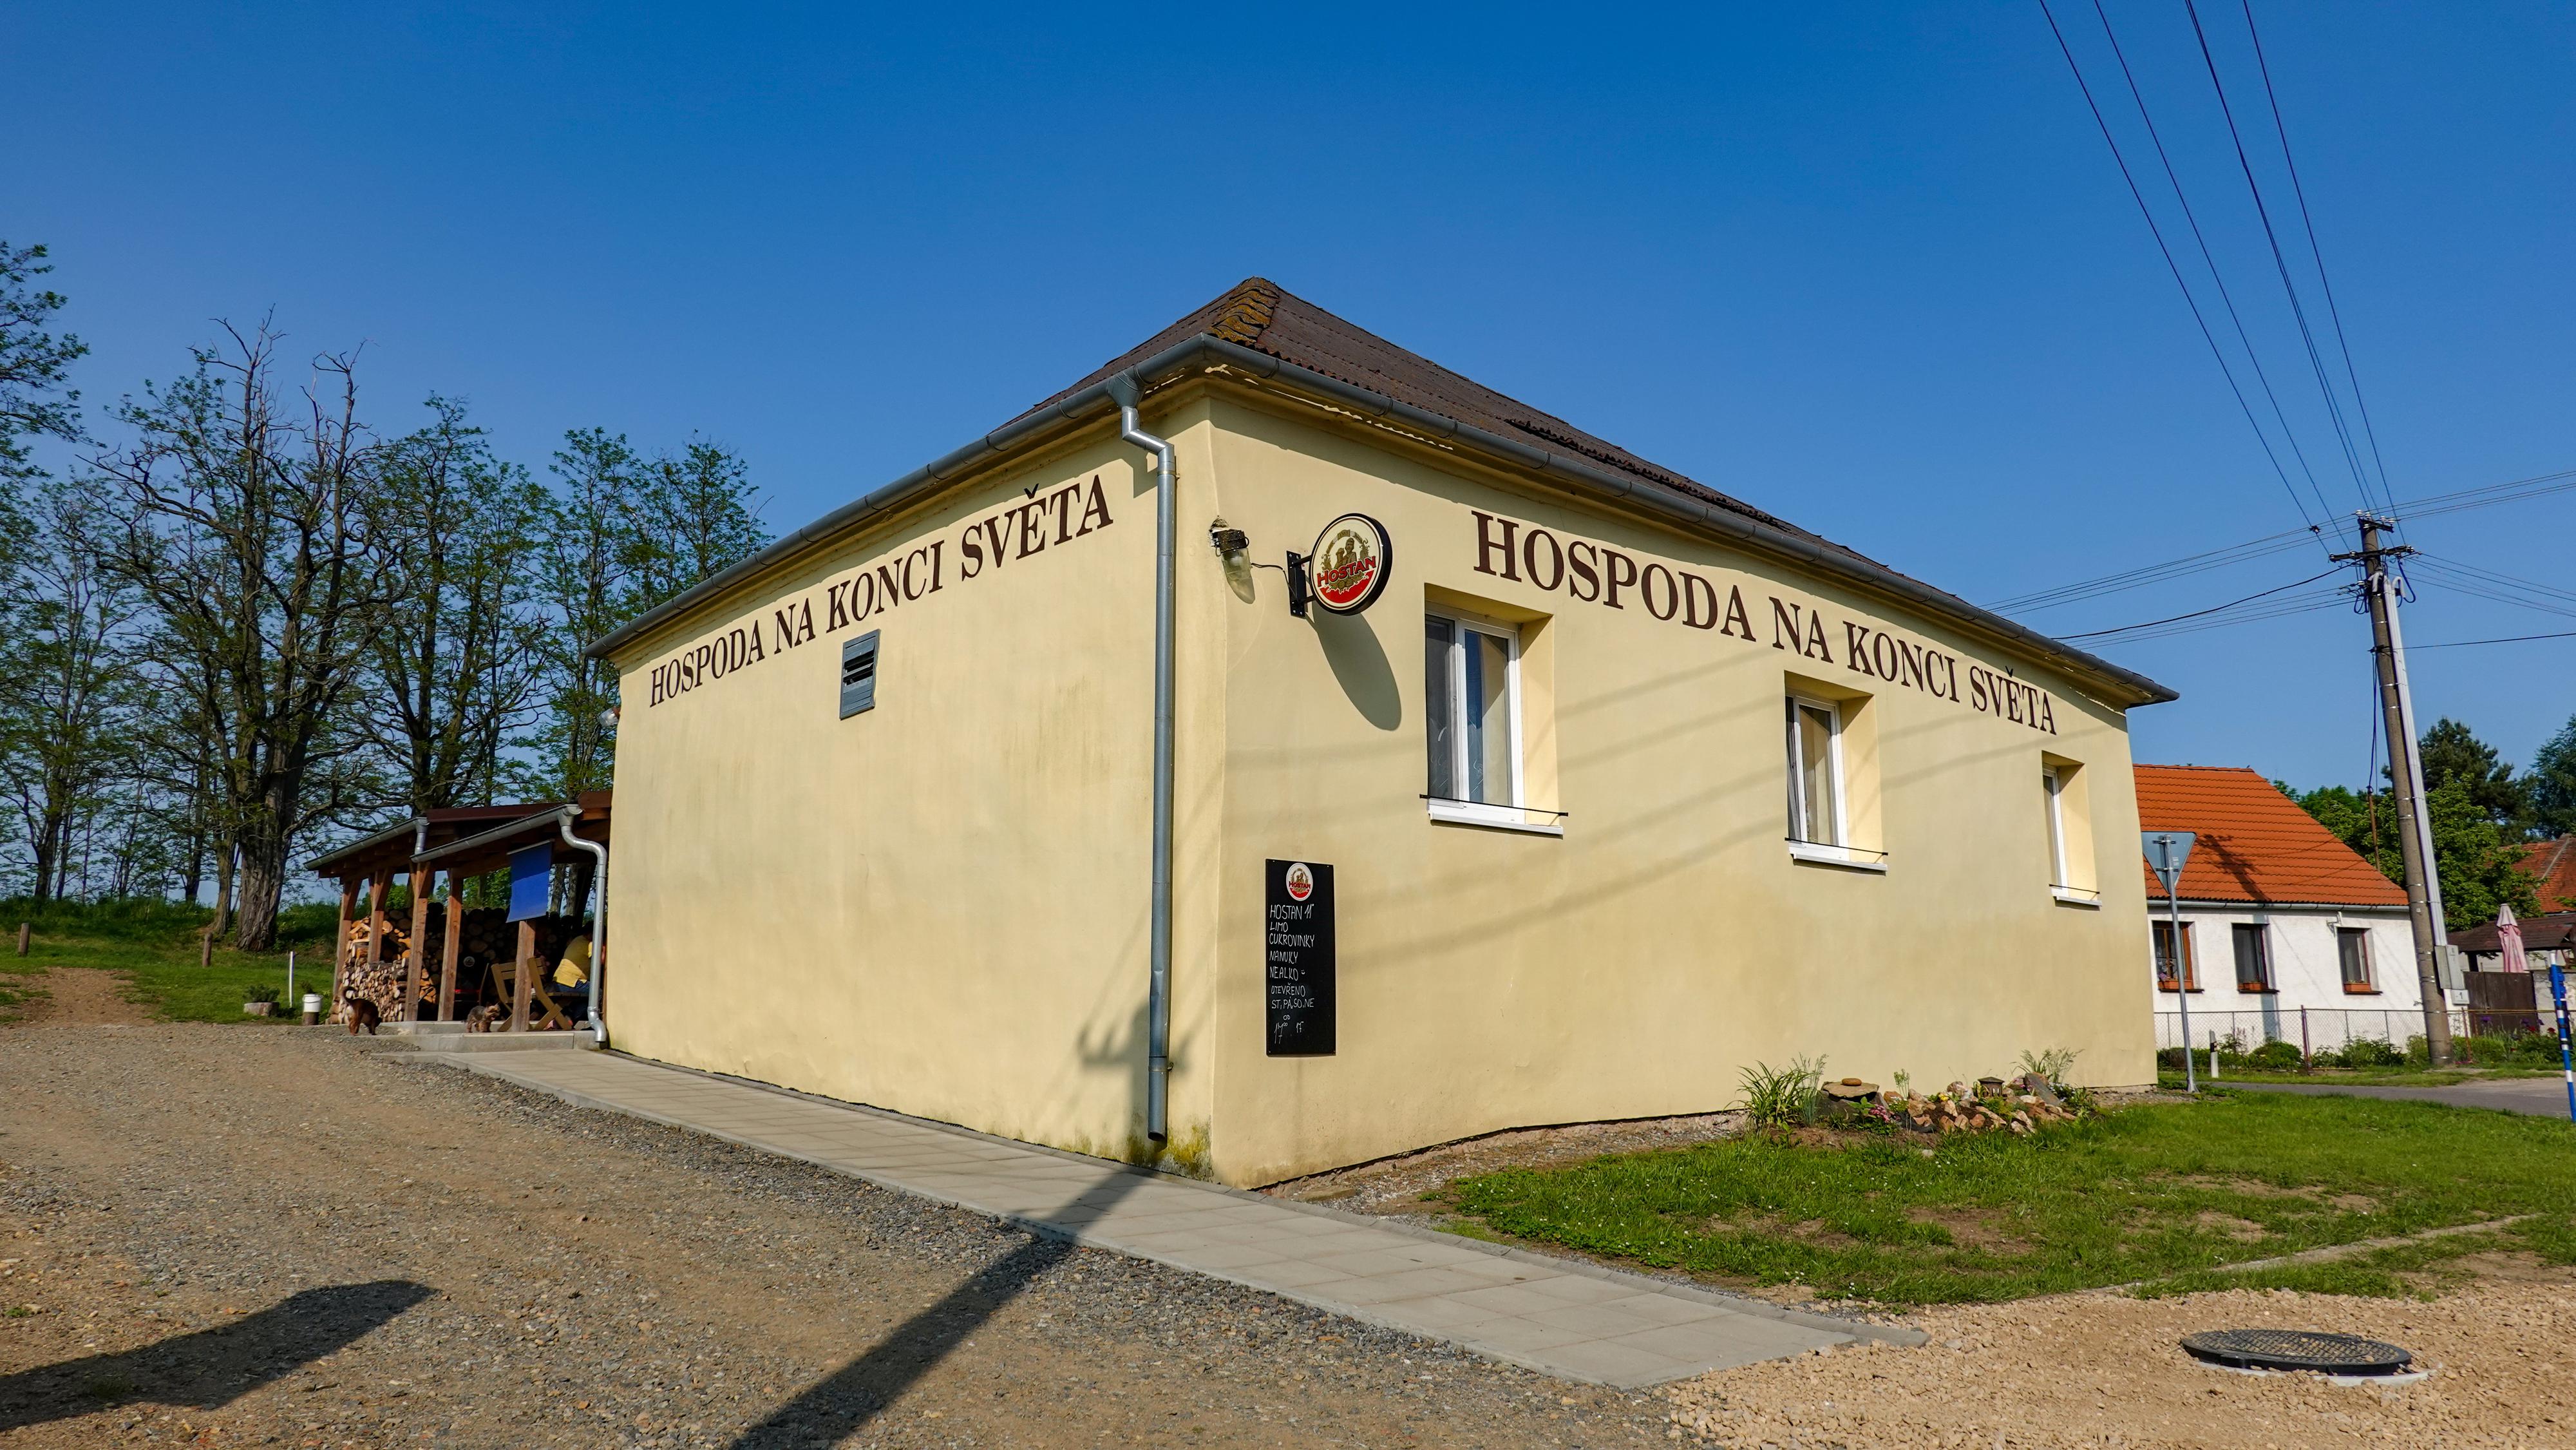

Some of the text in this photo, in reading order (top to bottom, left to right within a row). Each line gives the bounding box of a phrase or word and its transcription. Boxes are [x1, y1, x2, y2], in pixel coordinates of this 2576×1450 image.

[1316, 555, 1376, 587] HOSTAN
[649, 474, 1113, 708] HOSPODA NA KONCI SVĚTA
[1471, 510, 2057, 736] HOSPODA NA KONCI SVĚTA
[1289, 881, 1311, 889] HOSTAN
[1270, 904, 1302, 920] HOSTAN
[1270, 921, 1289, 932] LIMO
[1269, 933, 1314, 948] CUKROVINKY
[1269, 950, 1298, 964] NANUKY
[1270, 966, 1298, 981] NEALKO
[1271, 982, 1305, 997] OTEVŘENO
